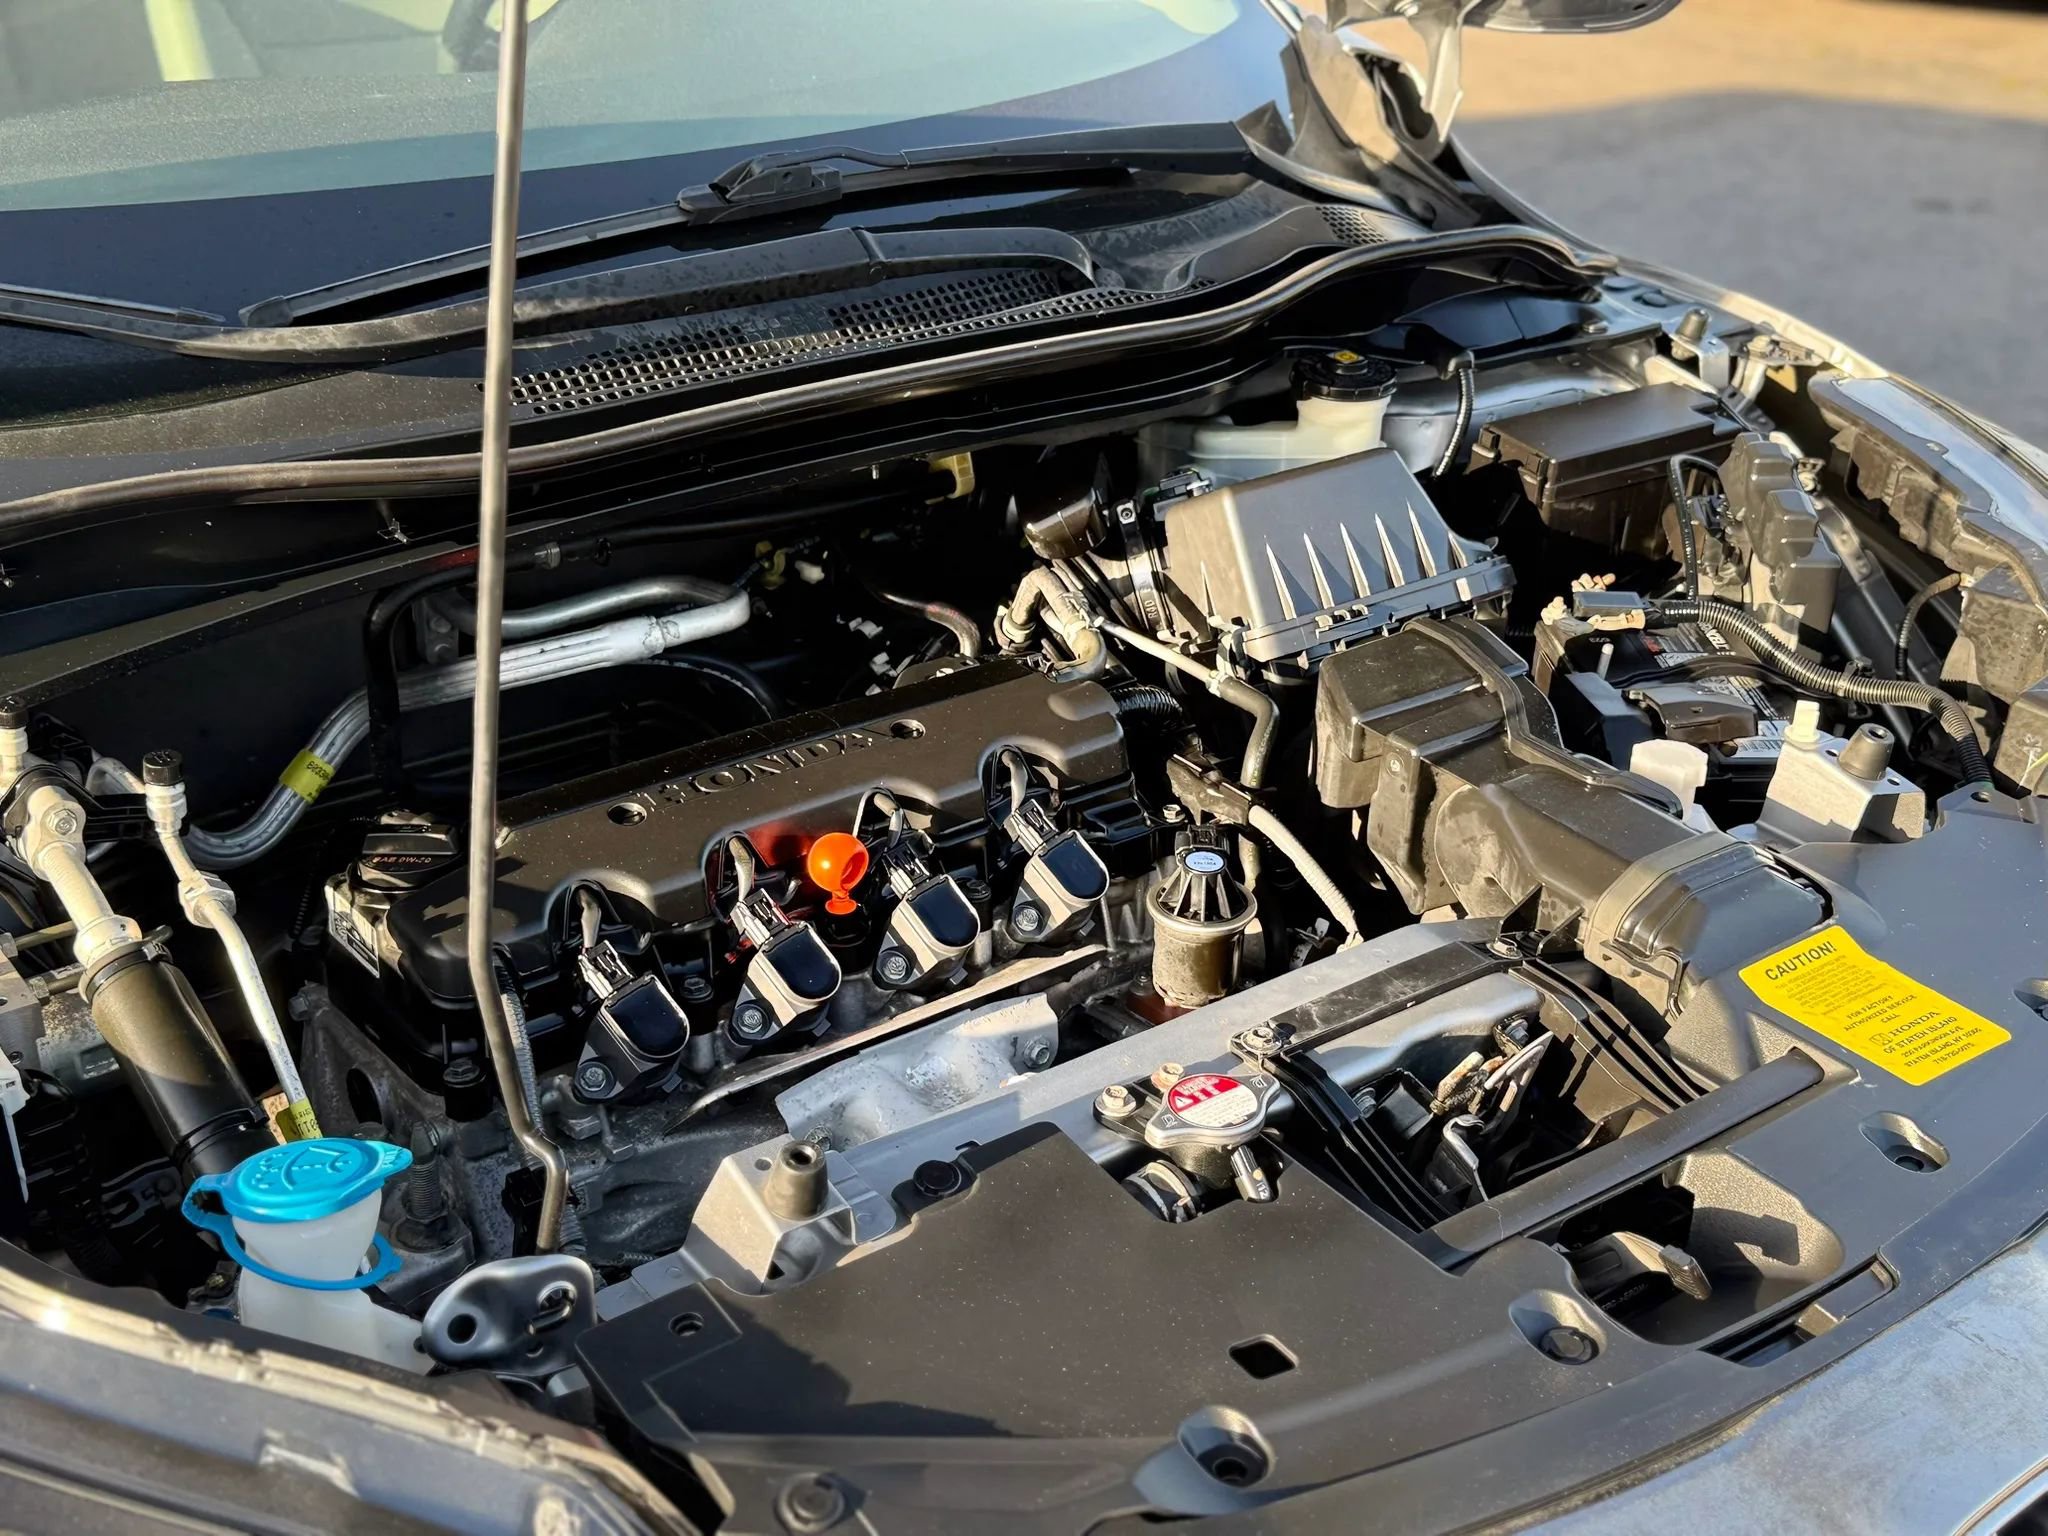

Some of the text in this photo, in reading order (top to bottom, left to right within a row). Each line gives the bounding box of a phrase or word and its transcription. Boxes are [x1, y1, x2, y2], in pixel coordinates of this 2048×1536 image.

[637, 732, 873, 812] HONDA
[1765, 940, 1838, 981] CAUTION!
[1843, 994, 1918, 1031] AUTHORIZED SERVICE
[1847, 995, 1895, 1020] FOR FACTORY
[1880, 1013, 1901, 1024] CALL
[1888, 1011, 1941, 1037] HONDA
[1883, 1016, 1958, 1054] OF STATEN ISLAND
